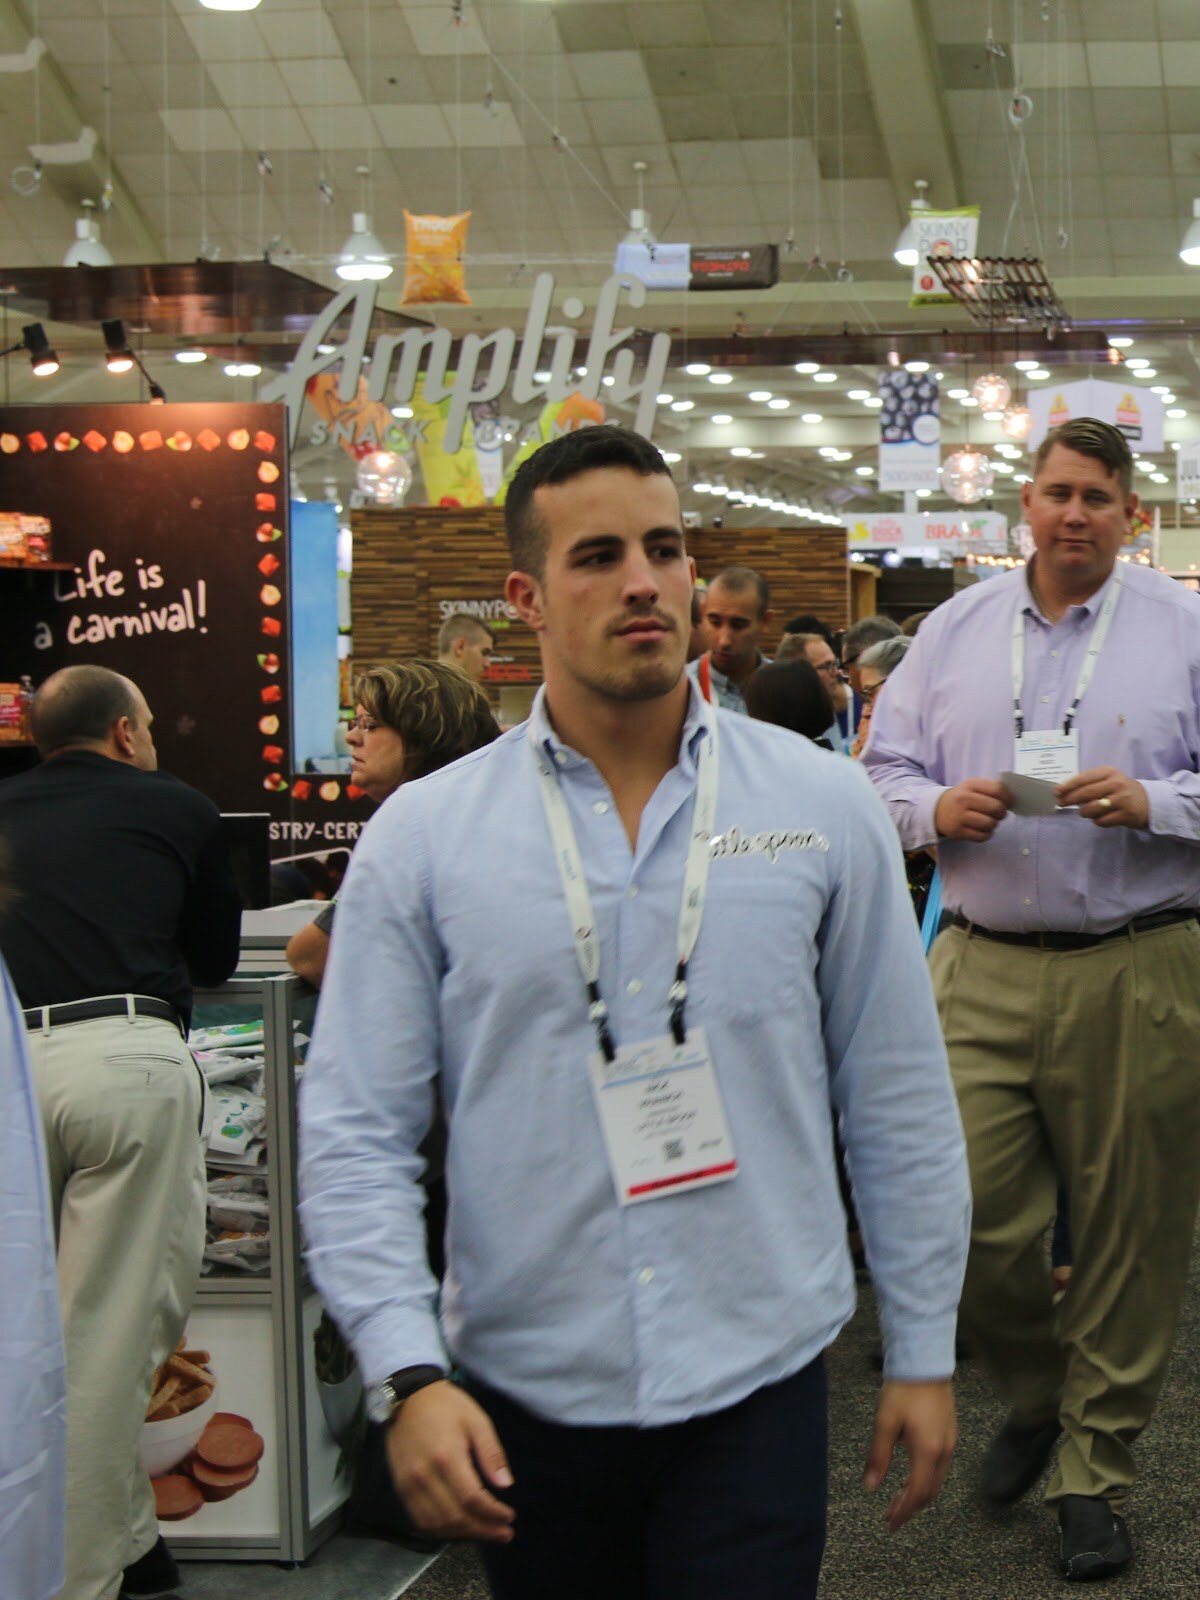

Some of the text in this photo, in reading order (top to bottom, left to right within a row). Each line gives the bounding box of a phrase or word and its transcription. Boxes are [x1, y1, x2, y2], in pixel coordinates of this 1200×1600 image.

[260, 272, 671, 454] Amplify
[310, 419, 430, 445] SNACK
[54, 549, 164, 602] Life is
[34, 579, 208, 650] a carnival!
